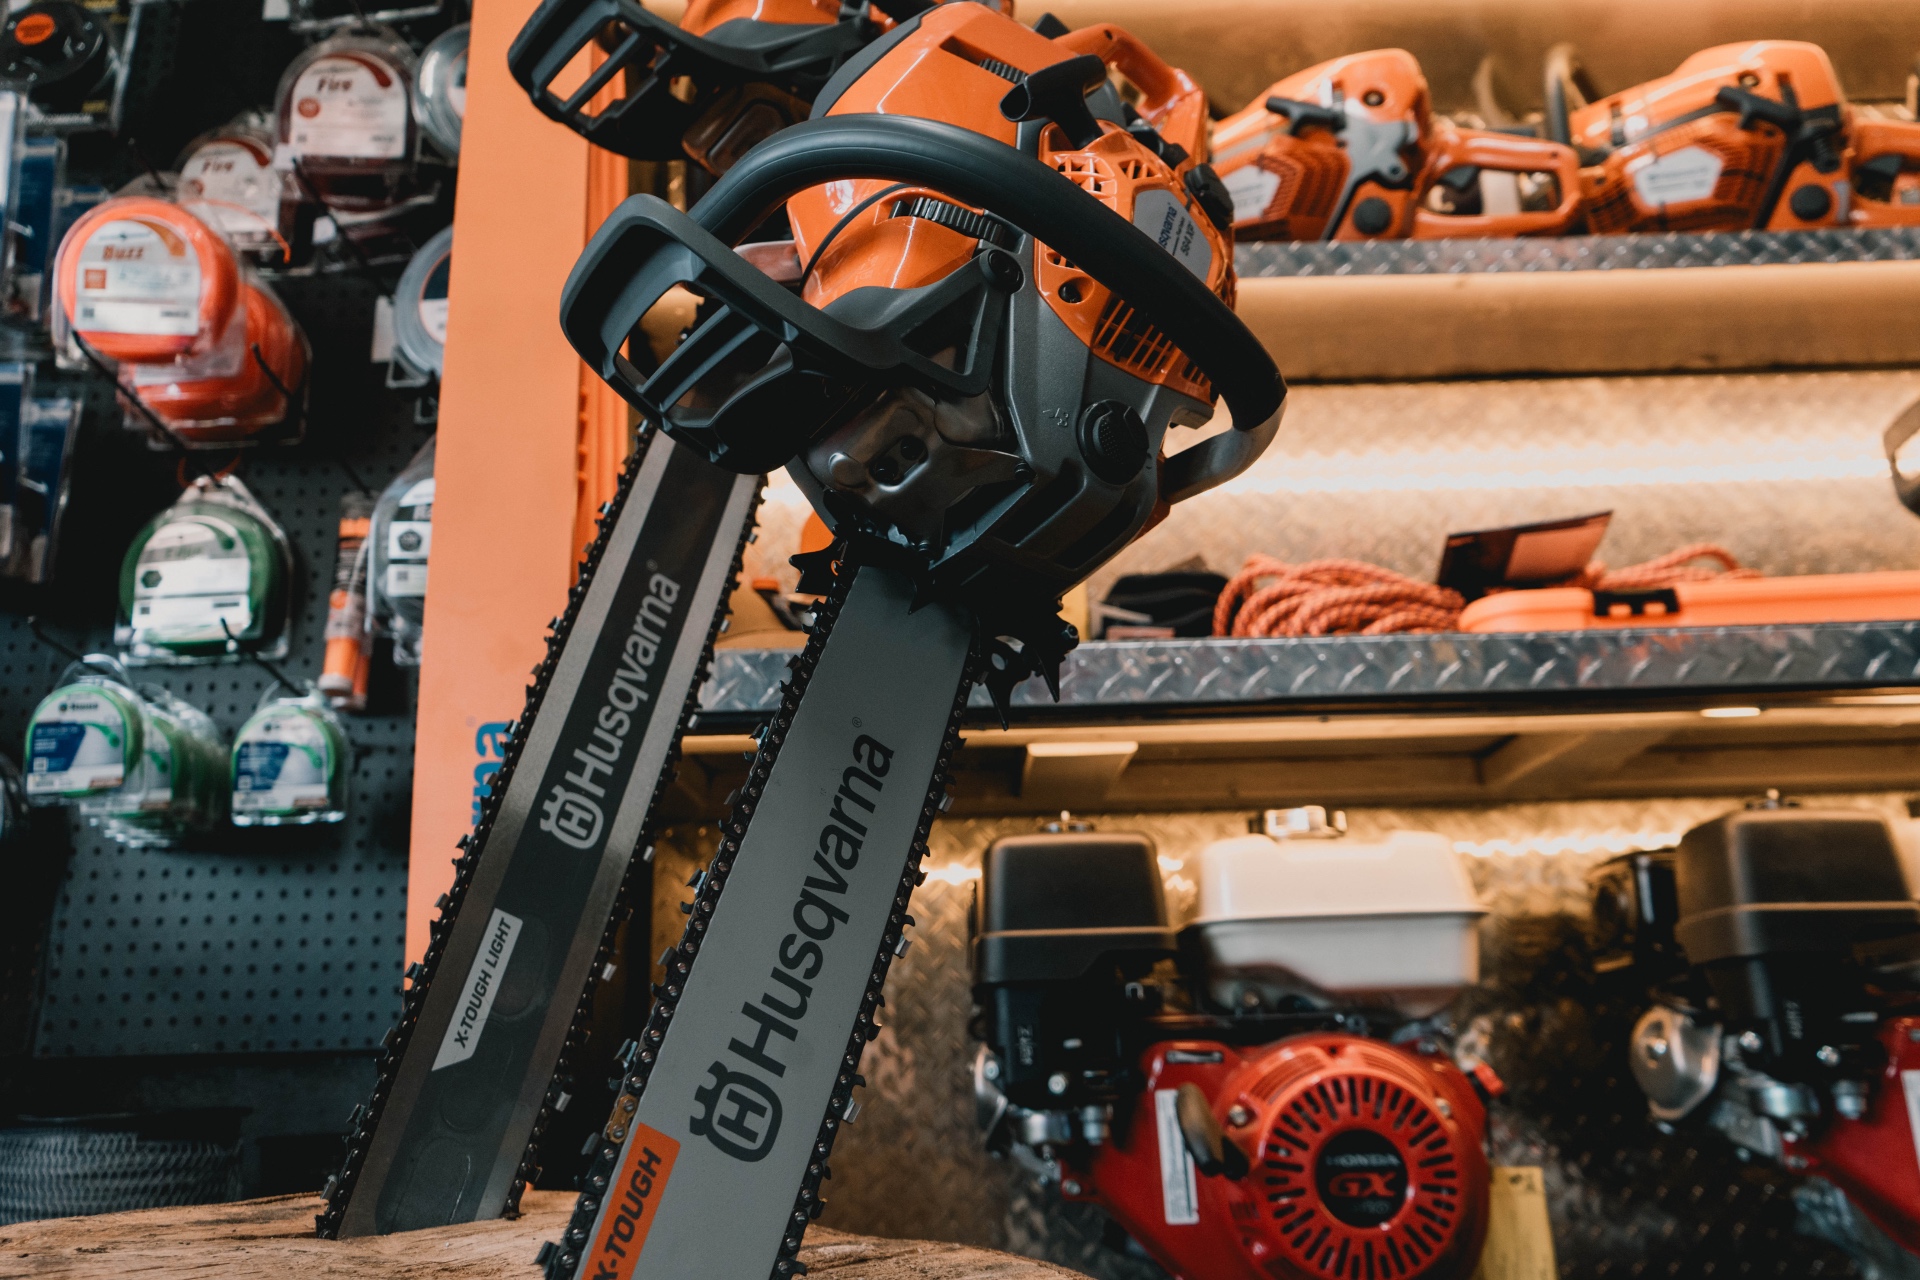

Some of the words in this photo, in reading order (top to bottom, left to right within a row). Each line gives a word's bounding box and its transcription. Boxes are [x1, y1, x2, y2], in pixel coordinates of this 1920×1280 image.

[565, 572, 680, 798] Husqvarna
[454, 969, 492, 1049] X-TOUGH
[485, 917, 511, 969] LIGHT
[727, 734, 895, 1078] Husqvarna
[1328, 1171, 1397, 1197] GX
